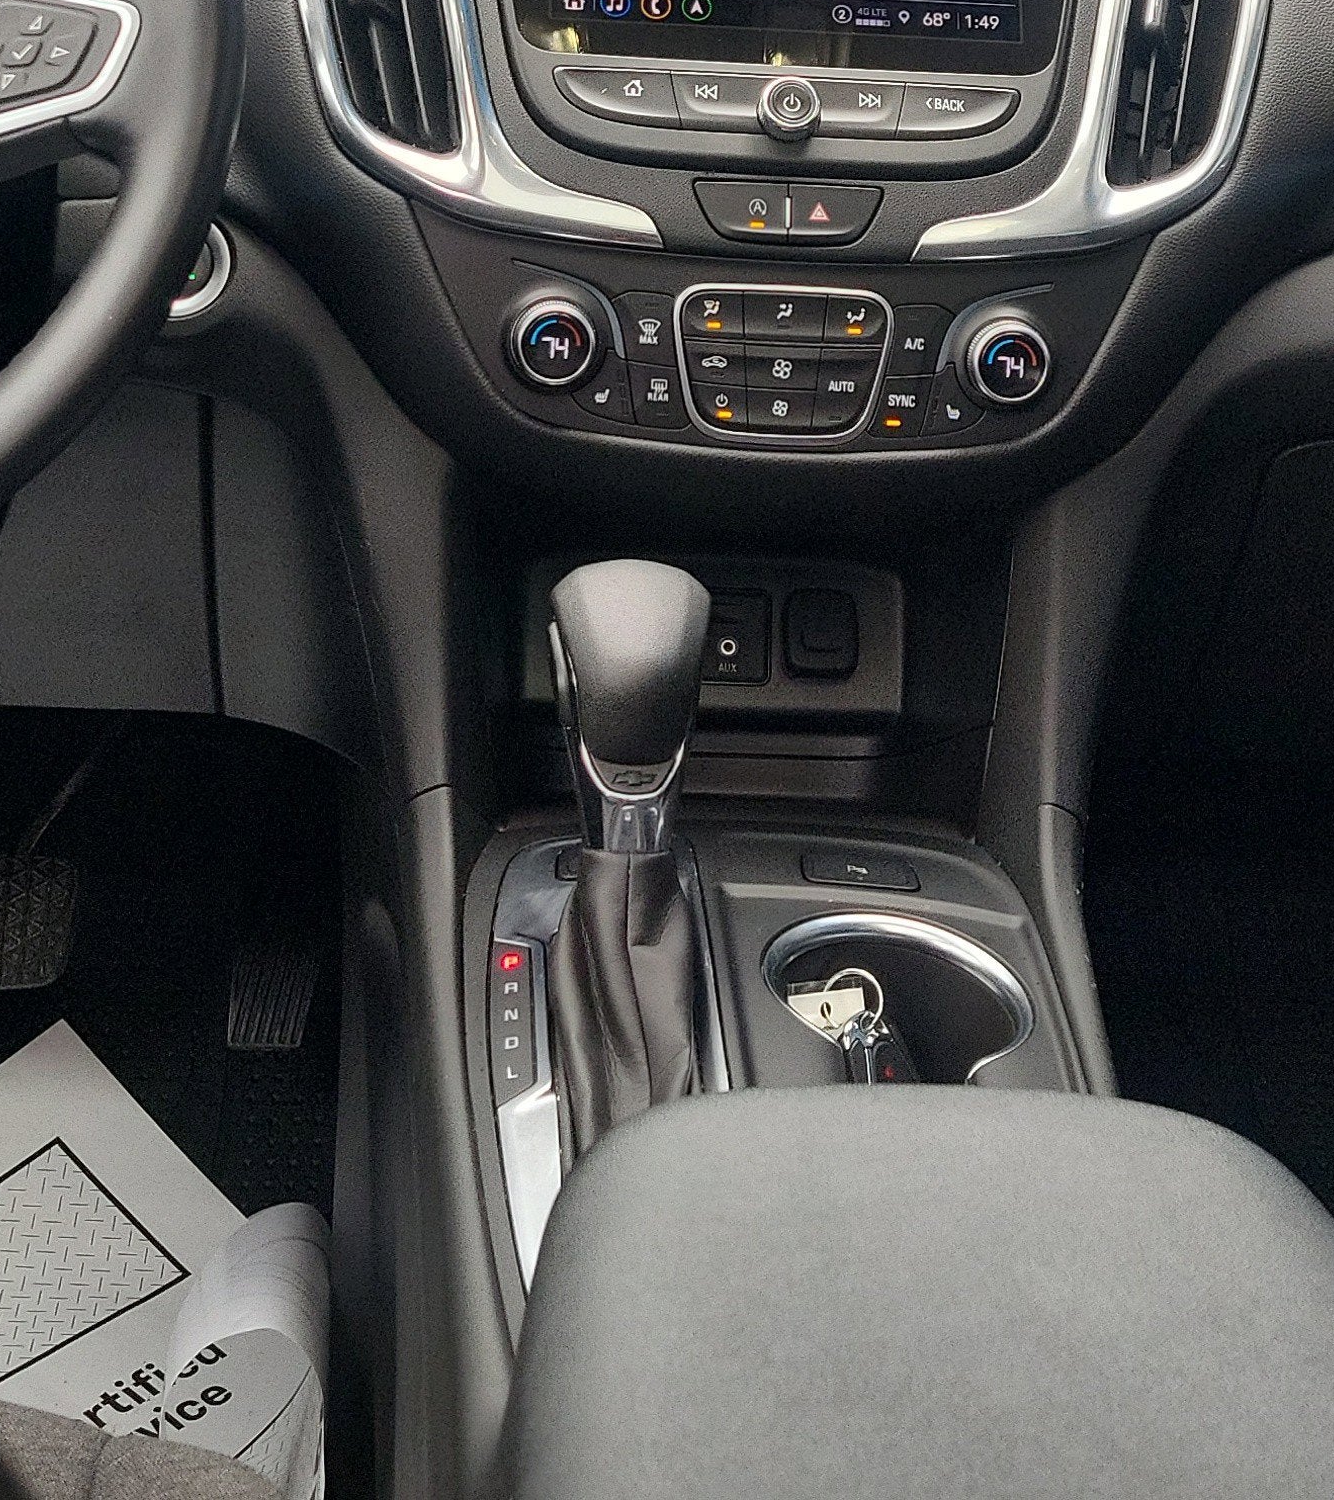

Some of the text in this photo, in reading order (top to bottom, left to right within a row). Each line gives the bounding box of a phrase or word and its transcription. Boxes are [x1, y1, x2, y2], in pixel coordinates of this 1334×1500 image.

[871, 8, 888, 17] LTE
[964, 14, 1000, 30] 1:49
[639, 335, 659, 345] MAX
[904, 338, 925, 351] A/C
[541, 336, 569, 360] 74
[997, 355, 1025, 379] 74
[828, 380, 855, 393] AUTO
[647, 392, 669, 403] REAR
[888, 393, 916, 407] SYNC
[718, 662, 737, 673] AUX
[503, 955, 519, 970] P
[504, 1007, 519, 1022] N
[504, 1035, 519, 1050] D
[506, 1066, 519, 1079] L
